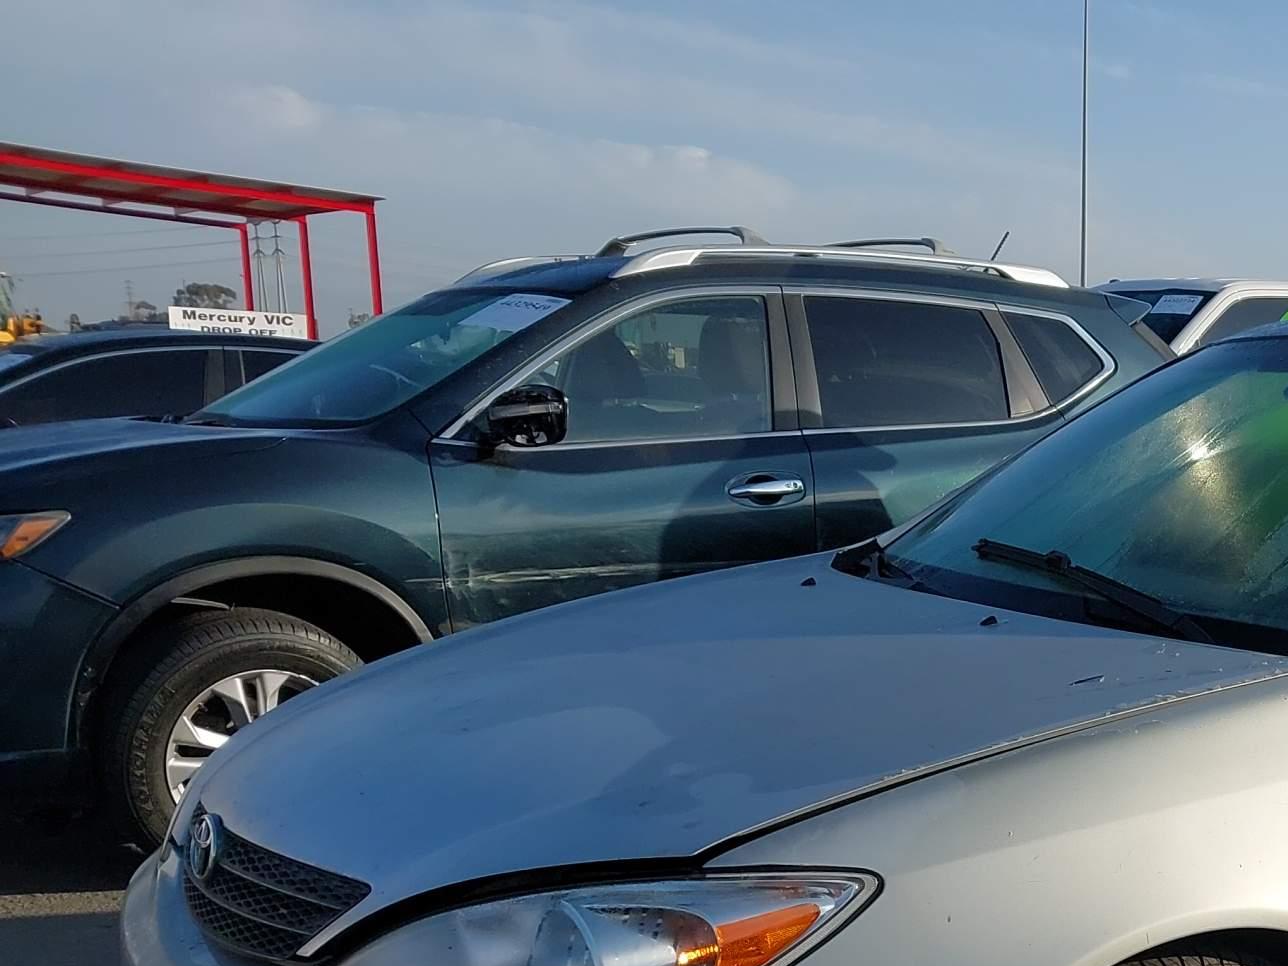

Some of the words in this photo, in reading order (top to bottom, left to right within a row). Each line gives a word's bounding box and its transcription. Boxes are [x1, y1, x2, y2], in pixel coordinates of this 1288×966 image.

[181, 309, 256, 326] Mercury
[264, 314, 294, 326] VIC
[201, 325, 242, 334] DROP
[248, 328, 278, 337] OFF
